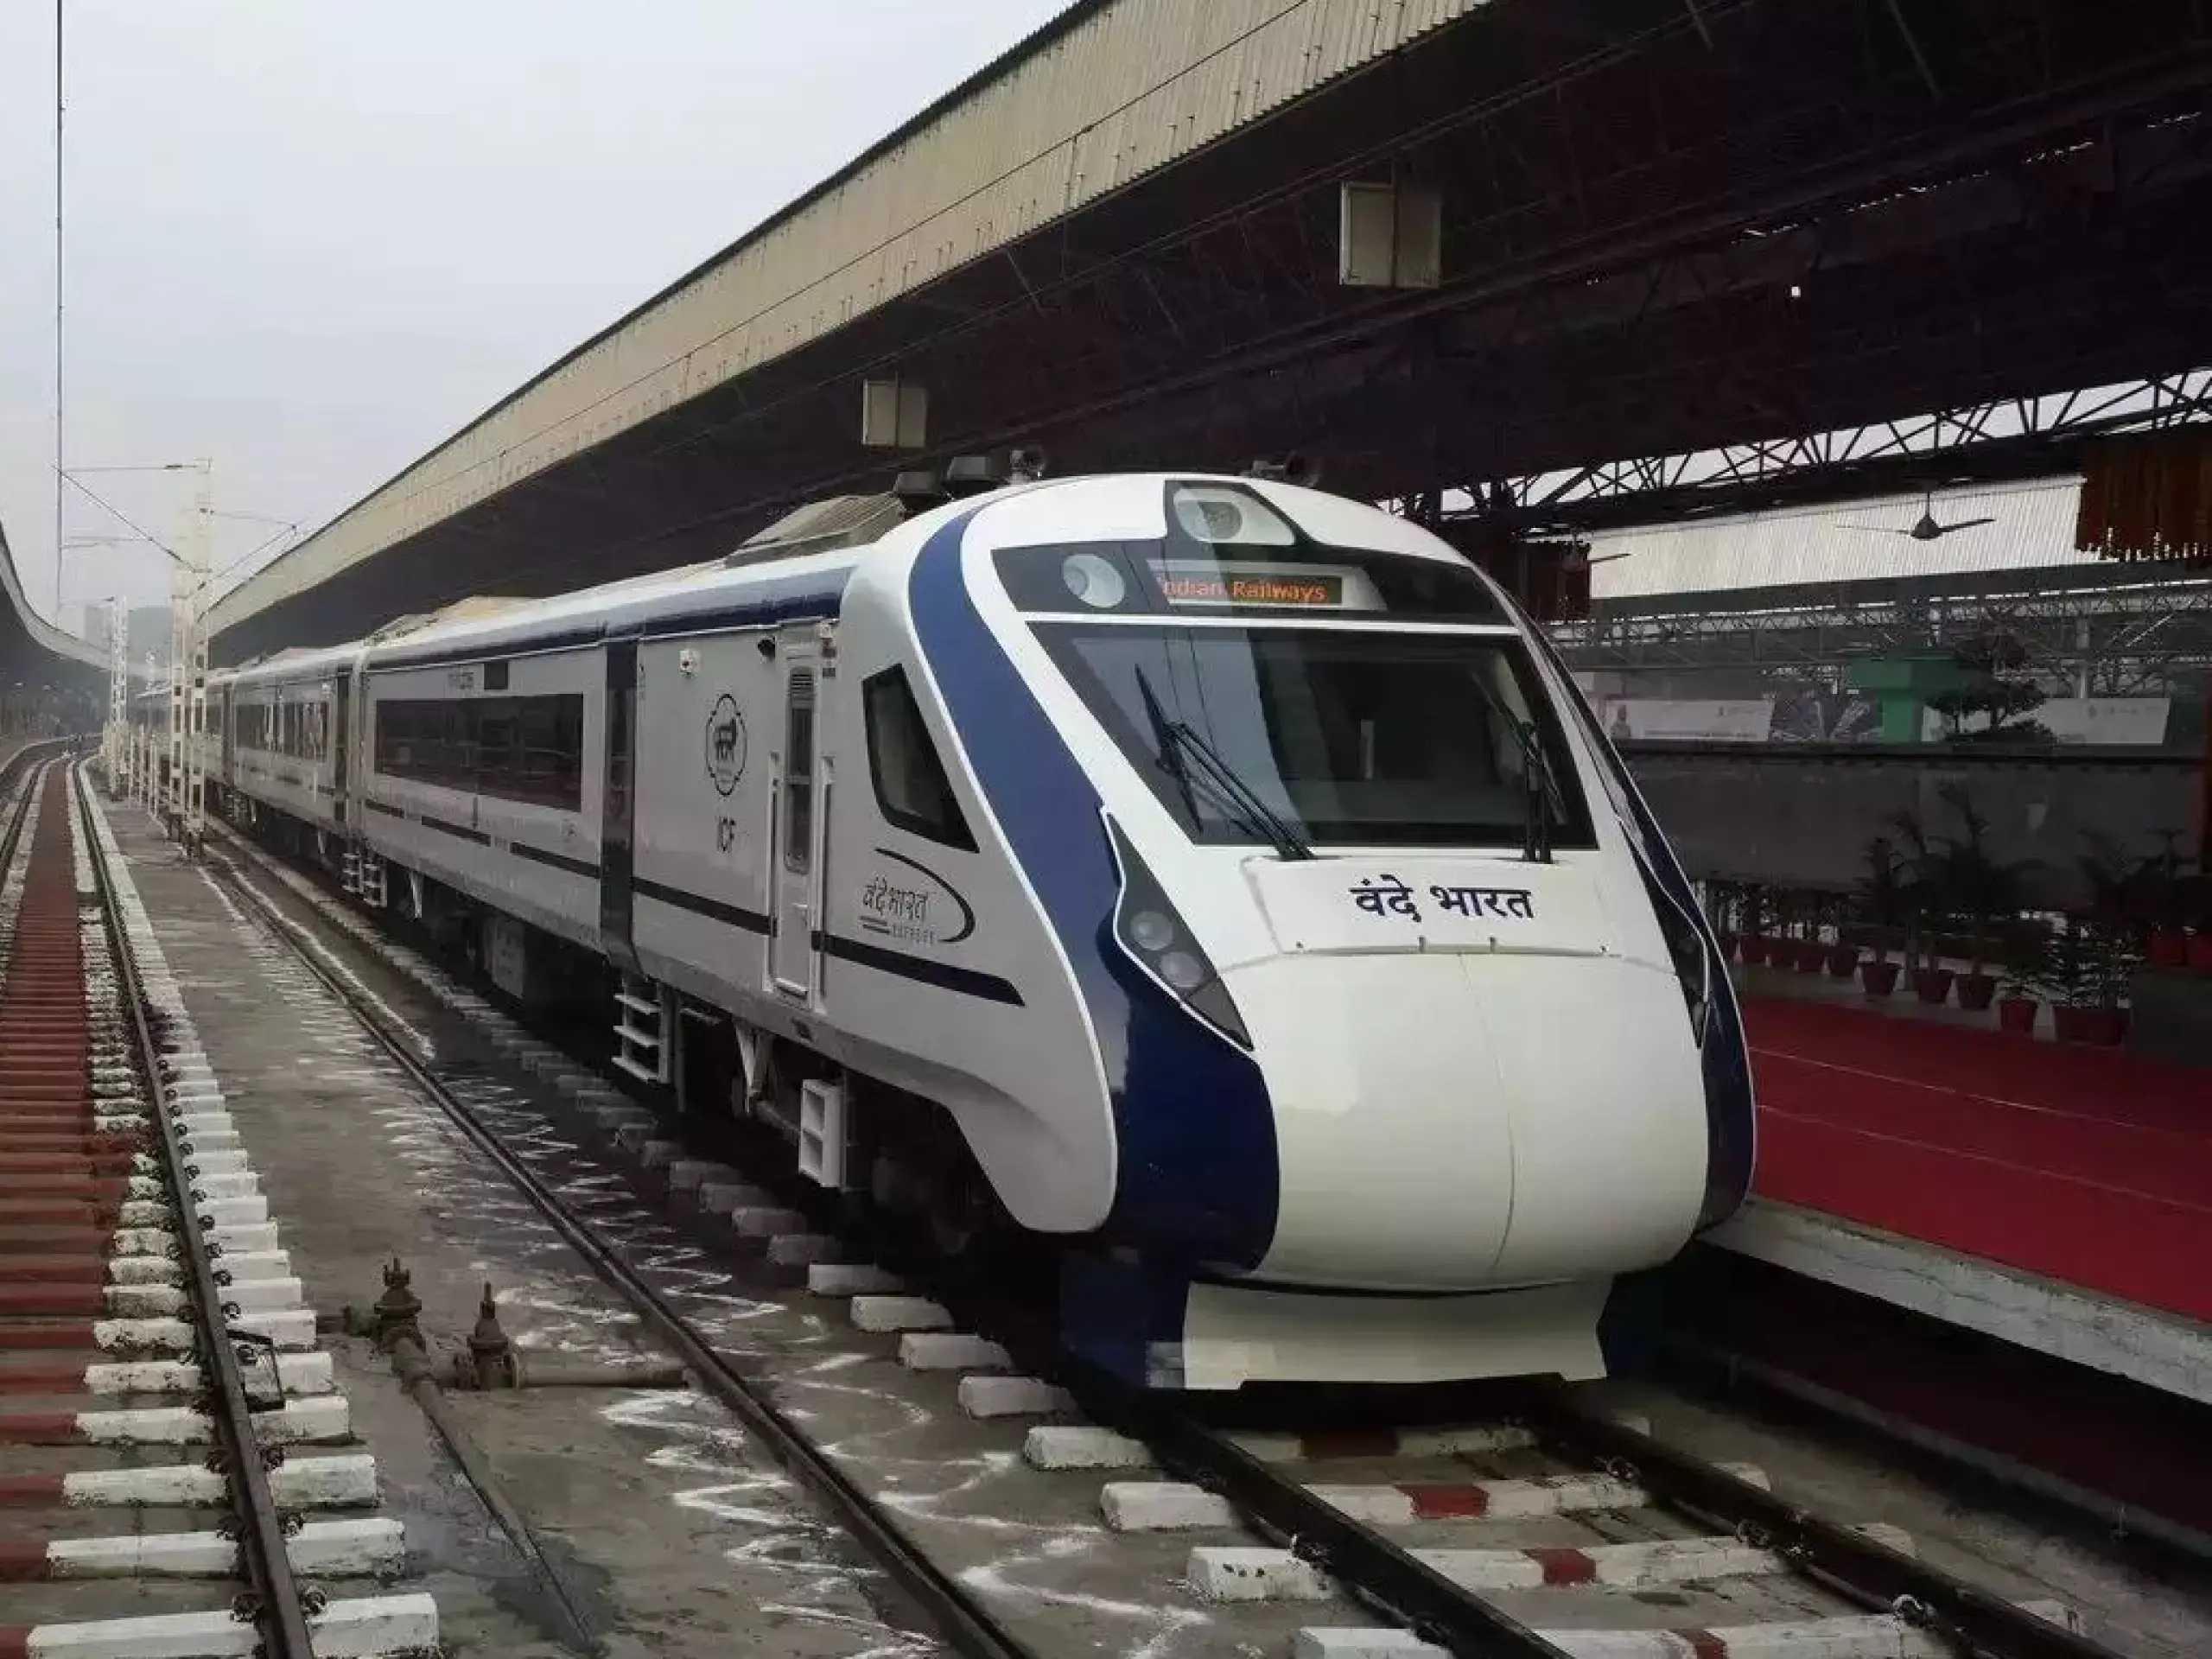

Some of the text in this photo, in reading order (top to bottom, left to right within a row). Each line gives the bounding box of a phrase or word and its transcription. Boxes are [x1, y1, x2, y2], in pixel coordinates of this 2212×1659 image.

[1233, 580, 1326, 604] Railways
[1350, 874, 1534, 923] वंदे भारत
